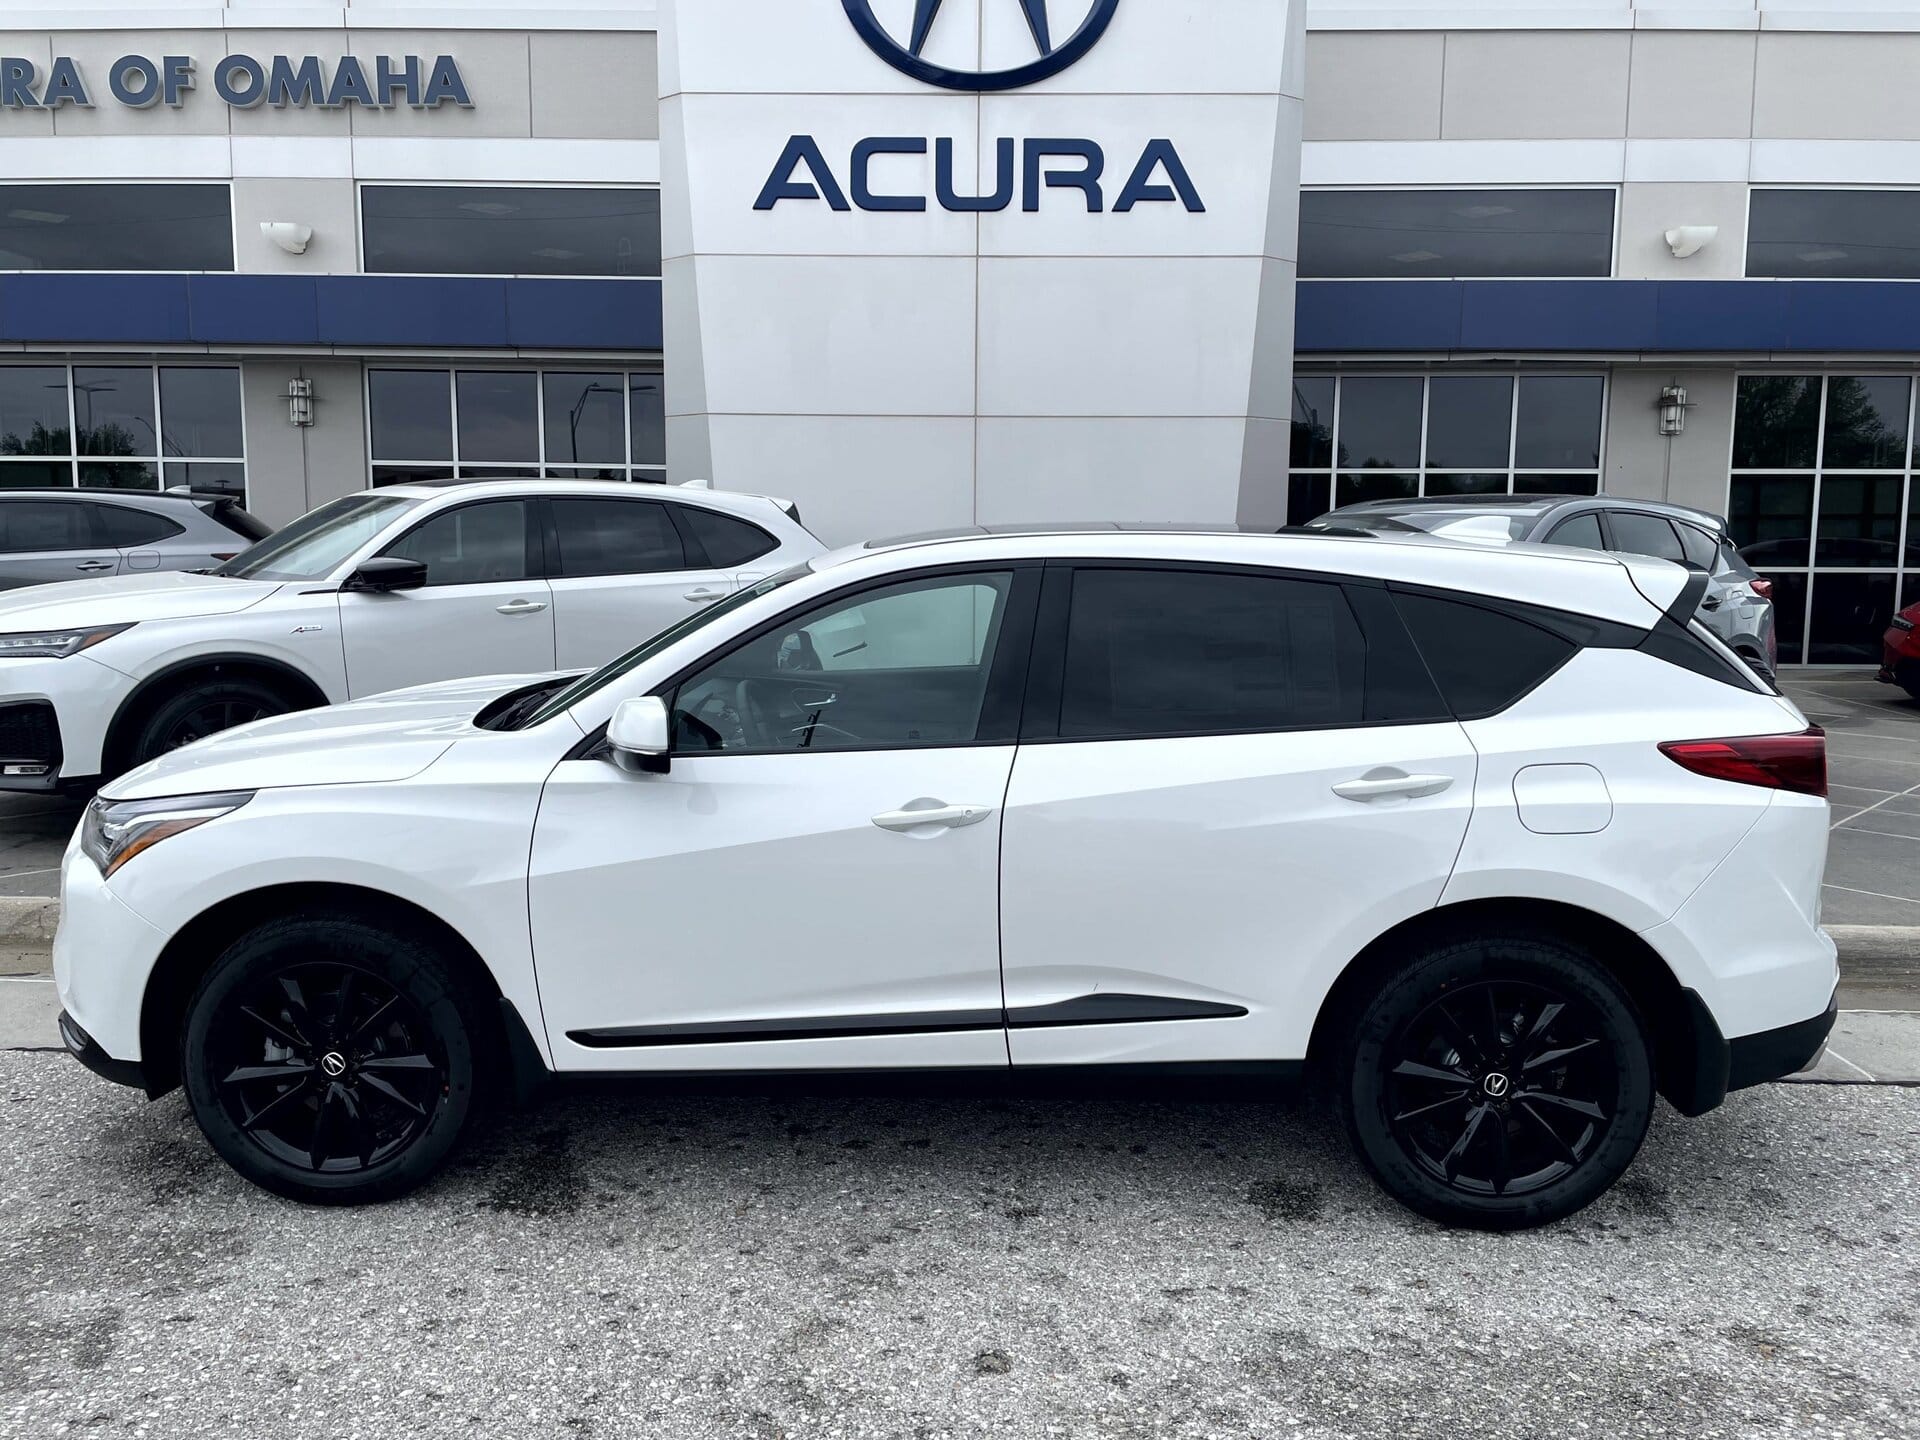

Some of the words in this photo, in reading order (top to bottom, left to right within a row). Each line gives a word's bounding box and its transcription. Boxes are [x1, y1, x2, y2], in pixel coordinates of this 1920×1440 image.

[108, 54, 196, 108] OF
[213, 53, 474, 108] OMAHA
[752, 134, 1206, 212] ACURA
